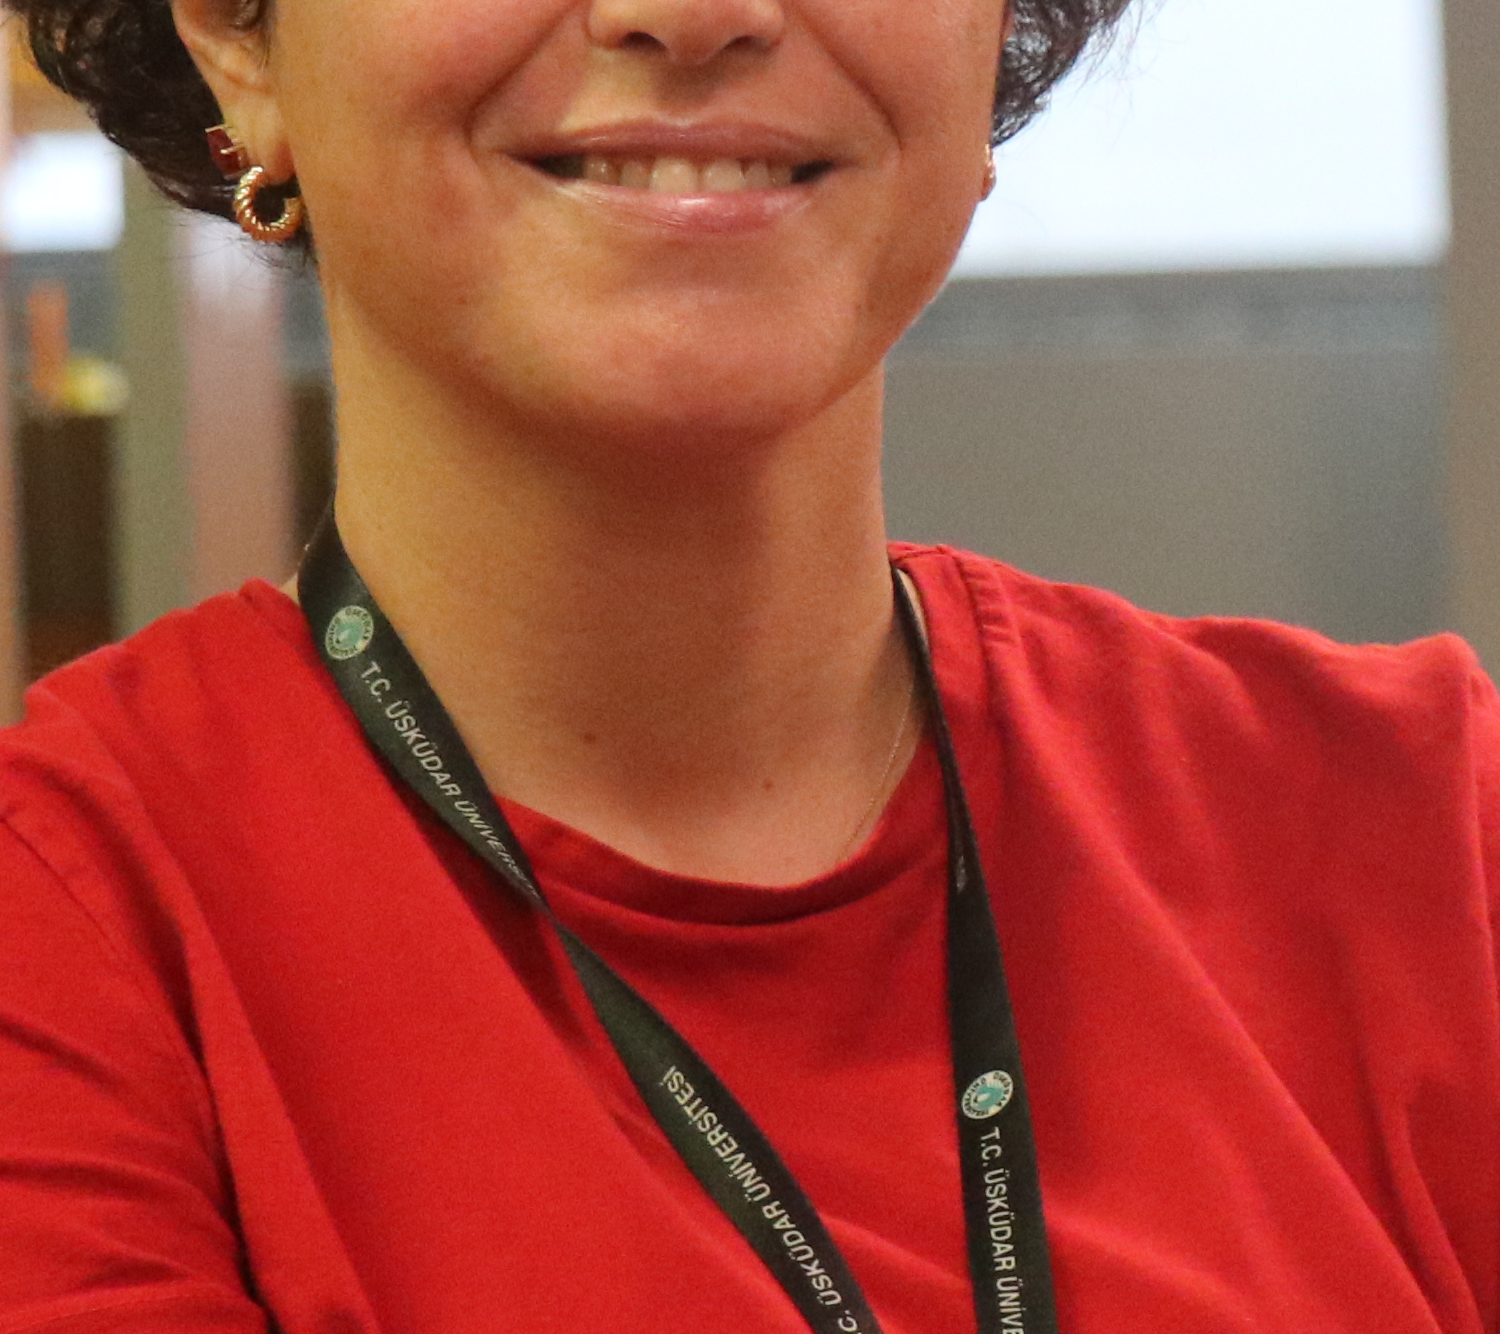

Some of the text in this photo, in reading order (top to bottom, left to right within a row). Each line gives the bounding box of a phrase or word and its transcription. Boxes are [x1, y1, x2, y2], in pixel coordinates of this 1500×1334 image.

[360, 661, 392, 703] T.C.
[385, 699, 462, 798] ÜSKÜDAR
[980, 1125, 1003, 1167] T.C.
[762, 1200, 843, 1307] ÜSKÜDAR
[984, 1170, 1016, 1272] ÜSKÜDAR
